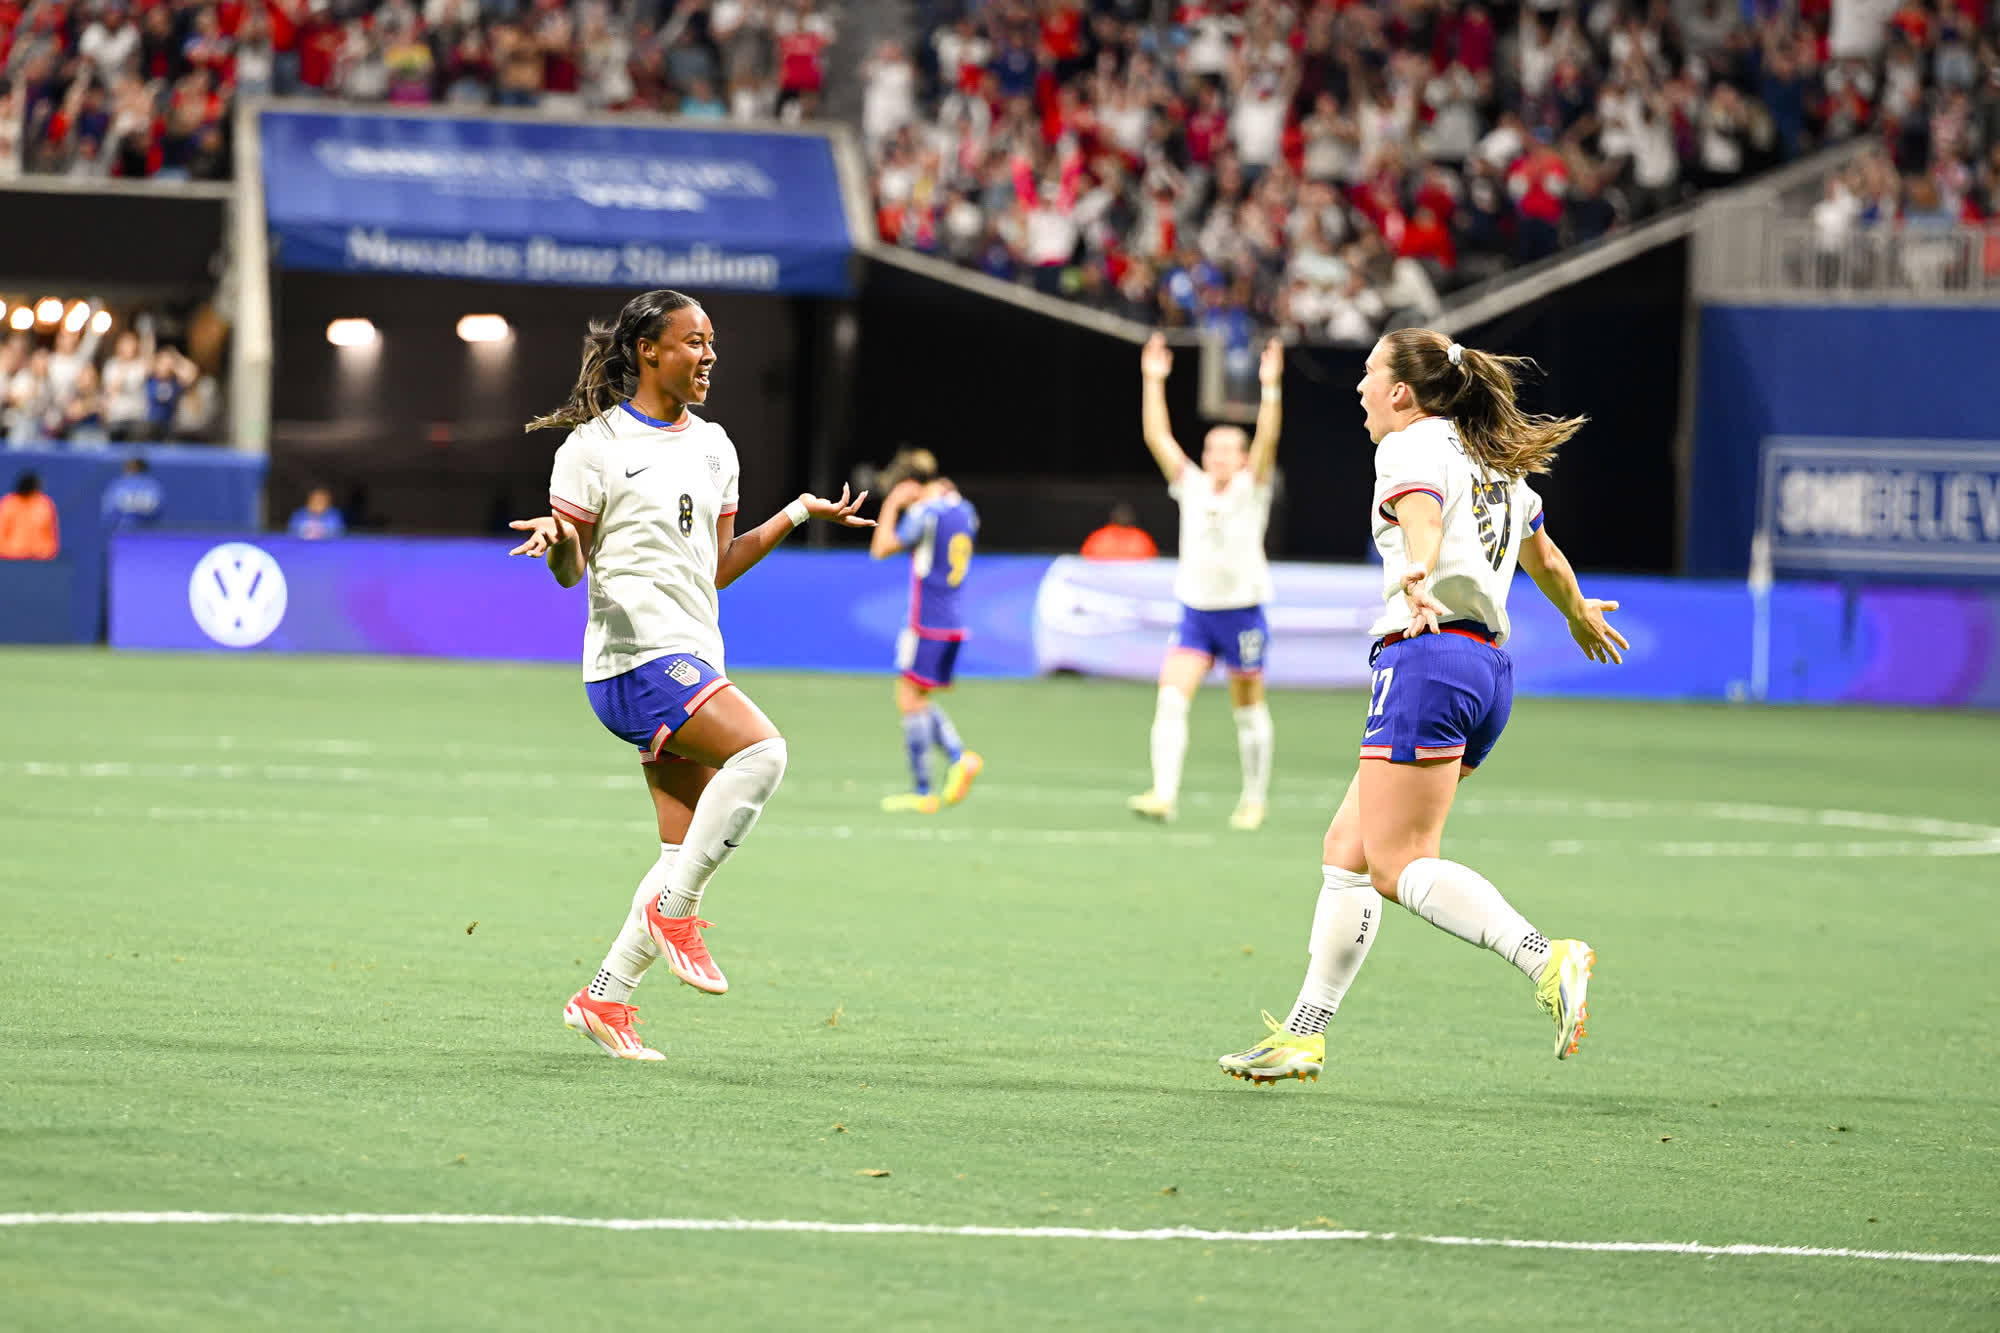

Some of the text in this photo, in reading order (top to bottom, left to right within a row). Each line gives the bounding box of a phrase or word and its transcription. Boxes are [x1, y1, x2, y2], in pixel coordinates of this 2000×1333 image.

[679, 494, 694, 537] 8
[1367, 667, 1394, 717] 17
[1355, 908, 1371, 945] USA
